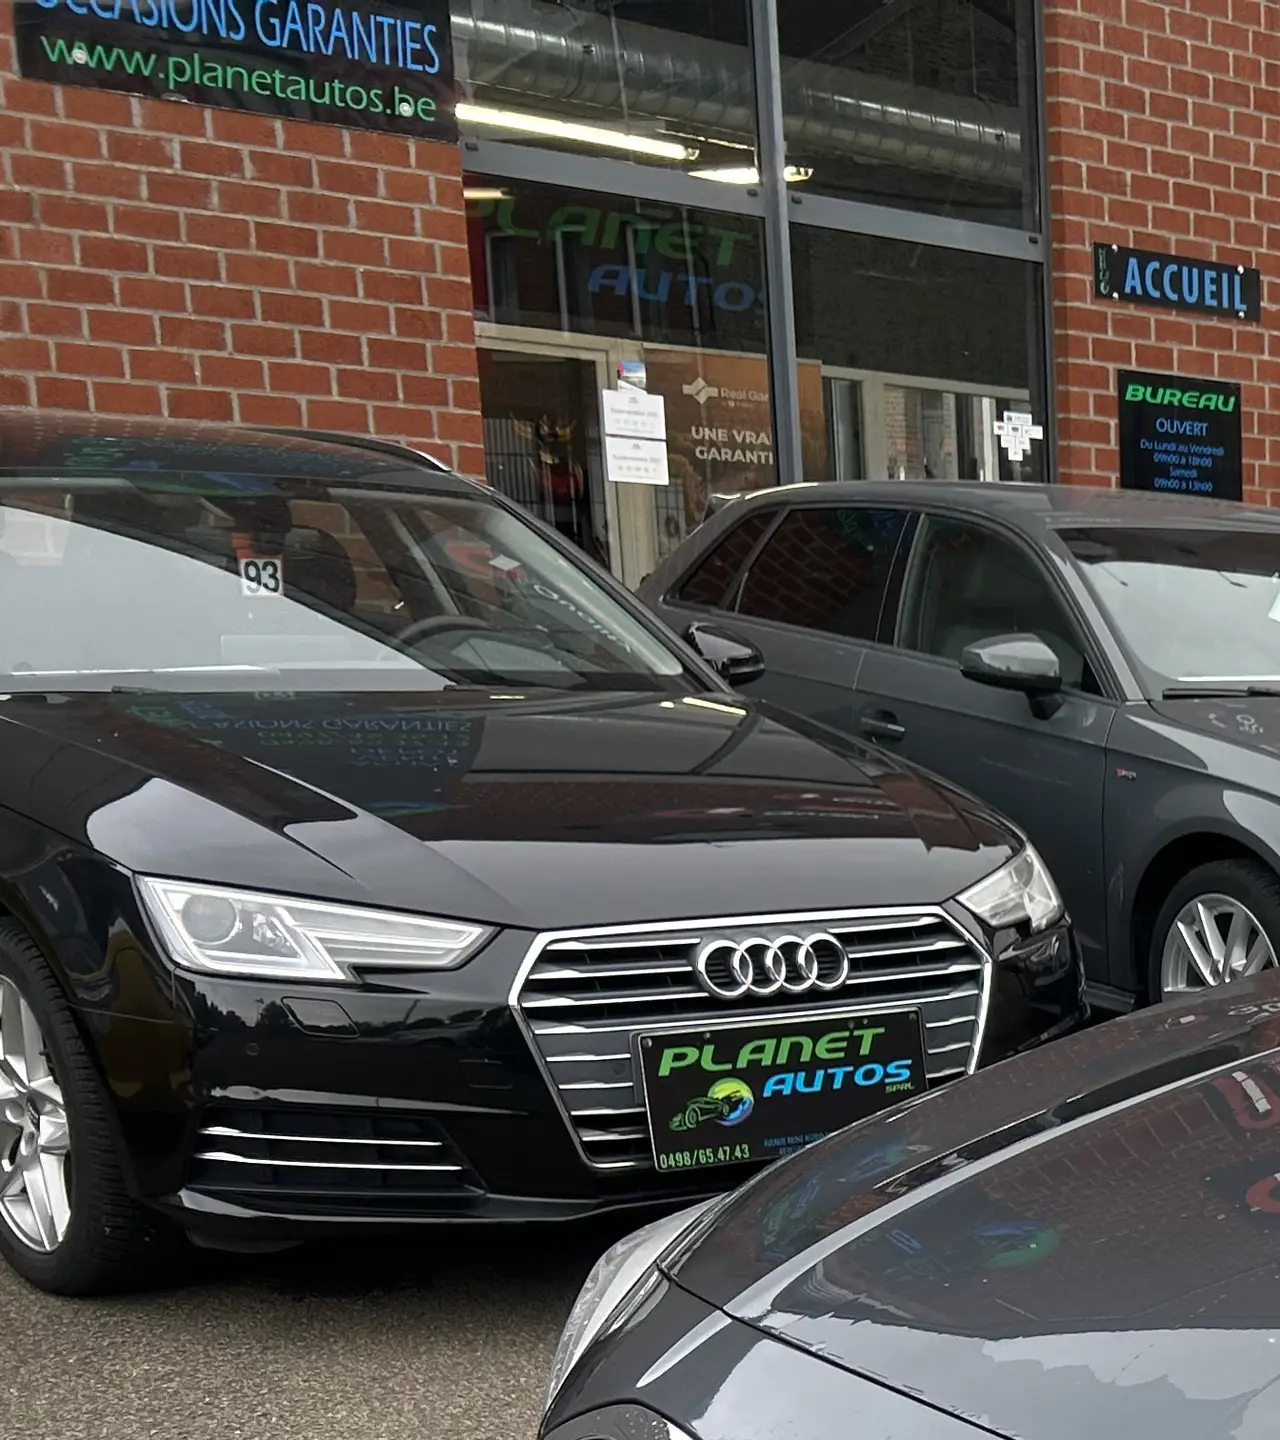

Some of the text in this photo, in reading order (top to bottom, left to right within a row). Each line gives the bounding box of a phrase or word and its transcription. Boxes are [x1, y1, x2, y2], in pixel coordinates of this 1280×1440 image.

[254, 0, 440, 74] GARANTIES
[40, 35, 437, 122] www.planetautos.be
[588, 264, 766, 312] AUTO
[1124, 257, 1248, 312] ACCUEIL
[1125, 383, 1237, 413] BUREAU
[690, 425, 728, 442] UNE
[1155, 418, 1209, 437] OUVERT
[1140, 438, 1153, 450] Du
[1154, 440, 1177, 452] Lundi
[1190, 444, 1225, 457] Vendredi
[243, 560, 281, 595] 93
[658, 1027, 885, 1077] PLANET
[763, 1059, 912, 1098] AUTOS
[884, 1082, 915, 1094] SPRL
[659, 1144, 750, 1170] 0498/65.47.43
